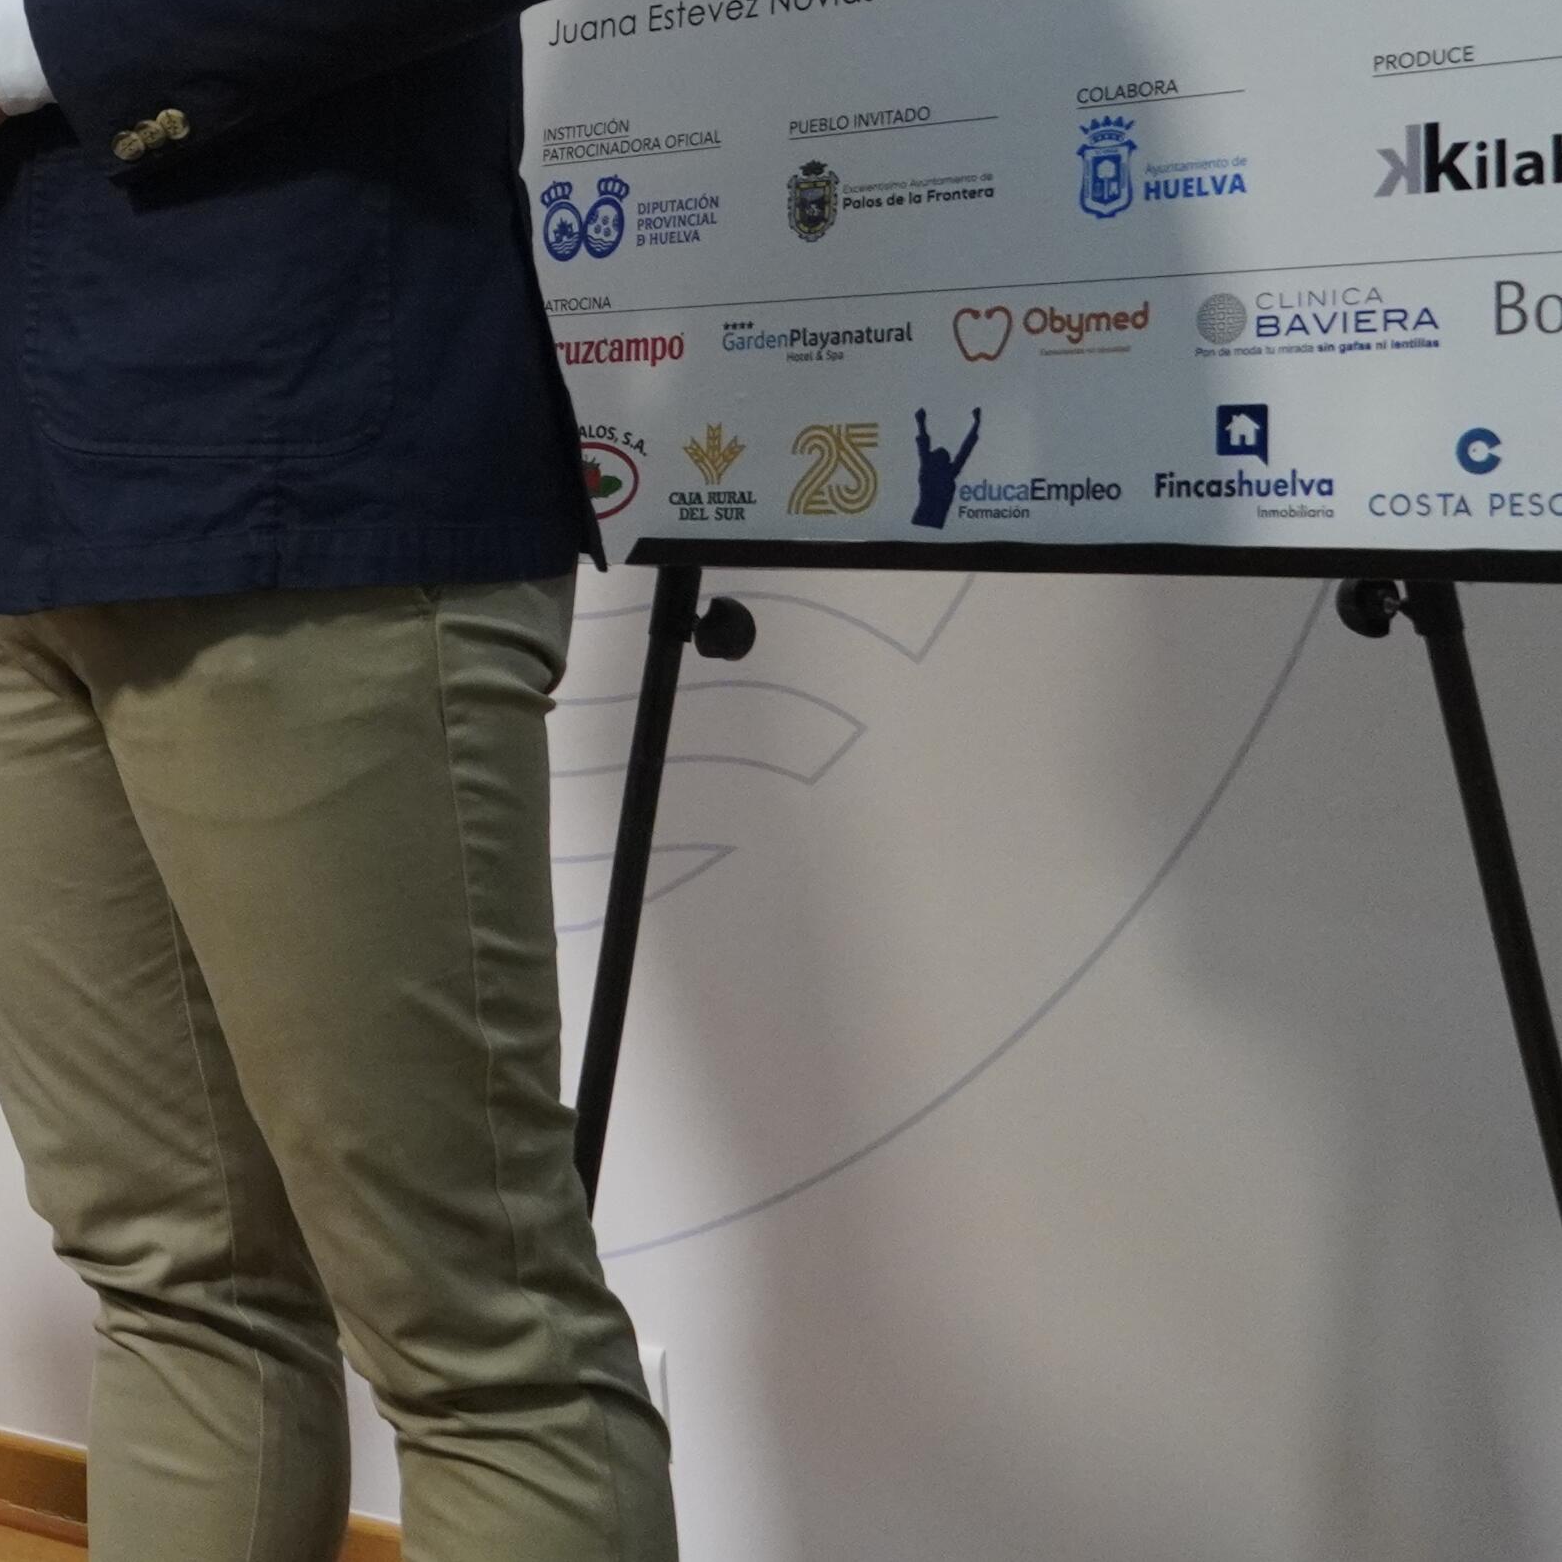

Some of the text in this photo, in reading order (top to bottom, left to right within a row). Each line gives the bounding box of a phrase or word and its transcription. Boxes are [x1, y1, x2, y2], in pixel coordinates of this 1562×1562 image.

[548, 14, 637, 47] Juana
[1373, 45, 1474, 72] PRODUCE
[1076, 79, 1180, 105] COLABORA
[543, 118, 630, 142] INSTITUCIÓN
[789, 106, 932, 136] PUEBLO INVITADO
[542, 129, 722, 163] PATROCINADORA OFICIAL
[1231, 154, 1248, 168] de
[842, 187, 995, 211] Palos de la Frontera
[1144, 173, 1247, 201] HUELVA
[636, 193, 720, 216] DIPUTACIÓN
[636, 211, 718, 232] PROVINCIAL
[649, 228, 701, 246] HUELVA
[544, 296, 612, 312] ATROCINA
[1255, 287, 1384, 310] CLINICA
[1023, 301, 1149, 344] Obymed
[1255, 307, 1440, 338] BAVIERA
[555, 334, 685, 368] ruzcampo
[1317, 342, 1335, 352] sin
[578, 423, 619, 444] ALOS,
[958, 476, 1122, 507] educaEmpleo
[1153, 468, 1335, 499] Fincashuelva
[668, 491, 757, 506] CAJA RURAL
[1368, 492, 1473, 517] COSTA
[678, 507, 746, 521] DEL SUR
[958, 504, 1030, 519] Formación
[1257, 505, 1335, 519] Inmobiliaria
